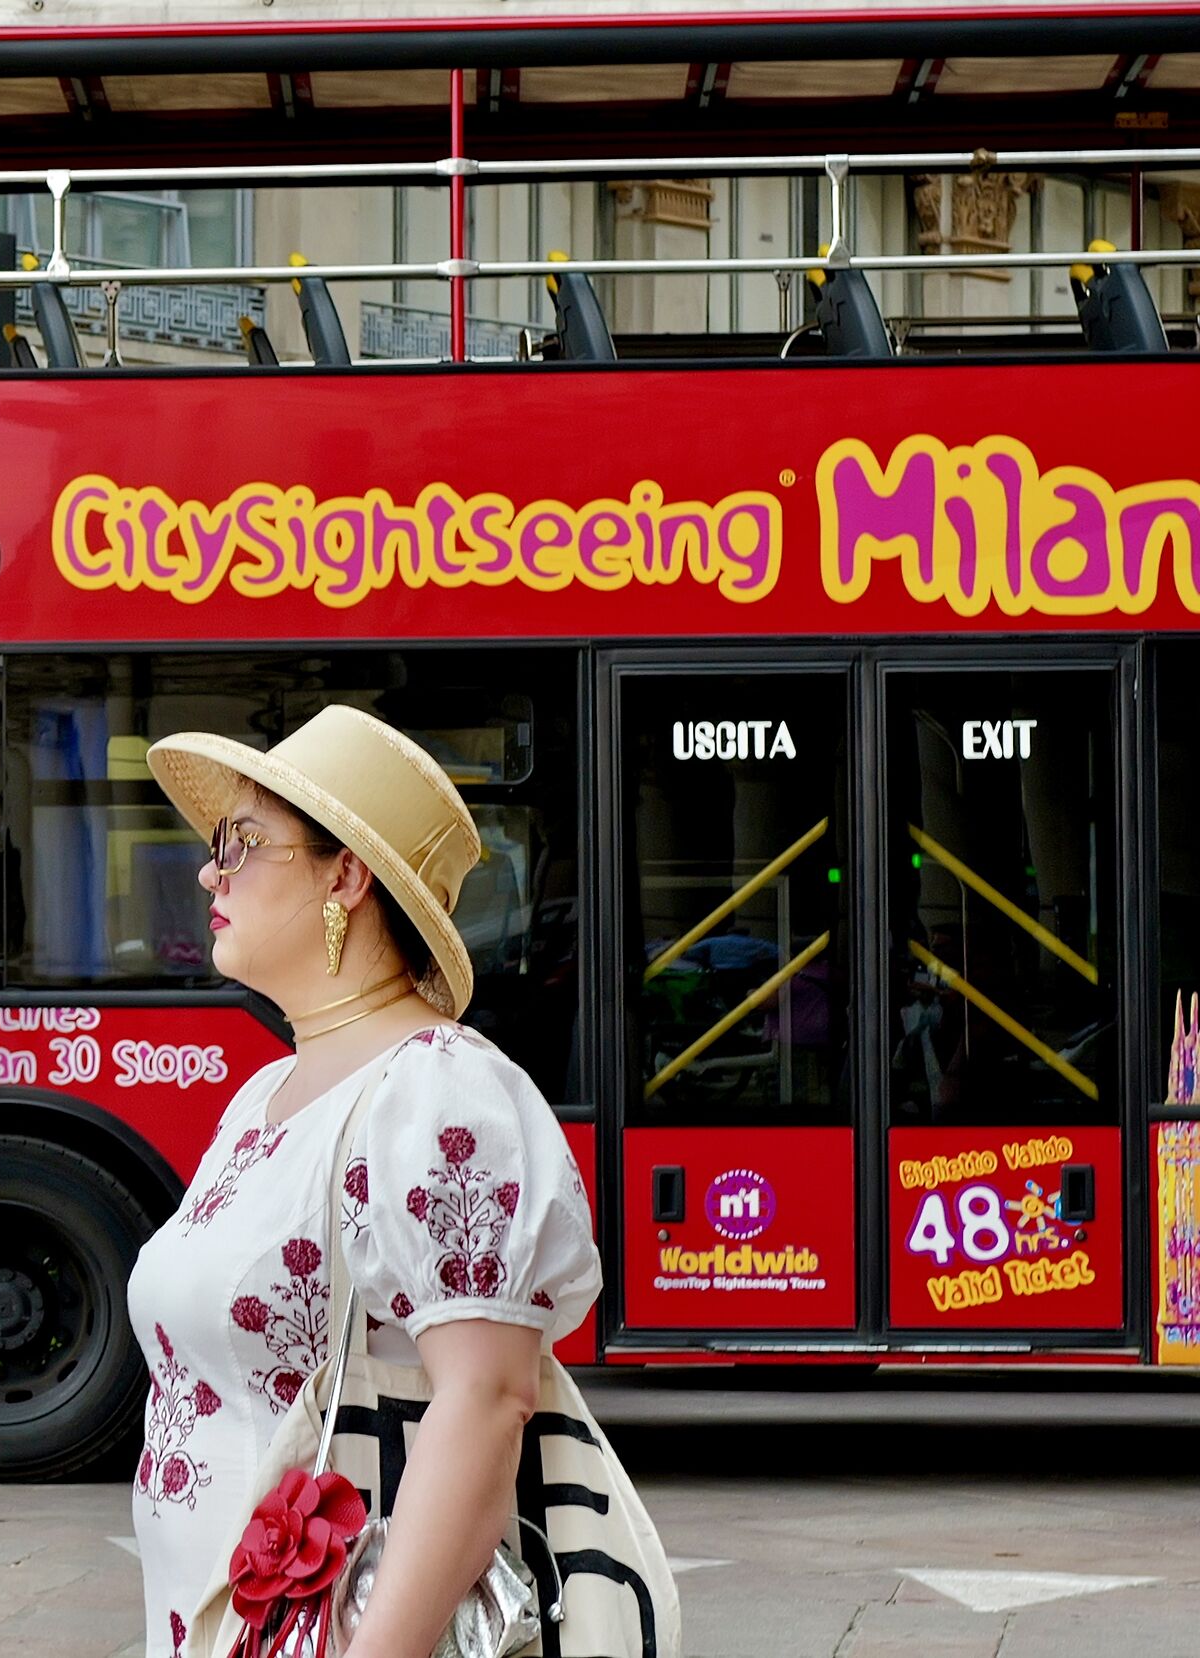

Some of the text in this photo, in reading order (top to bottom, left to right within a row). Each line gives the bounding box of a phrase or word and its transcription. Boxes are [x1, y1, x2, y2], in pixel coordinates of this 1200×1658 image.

[672, 720, 797, 761] USCITA
[962, 719, 1038, 760] EXIT
[48, 1034, 101, 1086] 30
[111, 1038, 229, 1090] Stops
[899, 1135, 1073, 1190] Biglietto Valido
[907, 1183, 1011, 1266] 48
[659, 1244, 820, 1276] Worldwide
[712, 1276, 789, 1292] Sightseeing
[789, 1276, 827, 1291] Tours
[926, 1250, 1096, 1313] Valid Ticket
